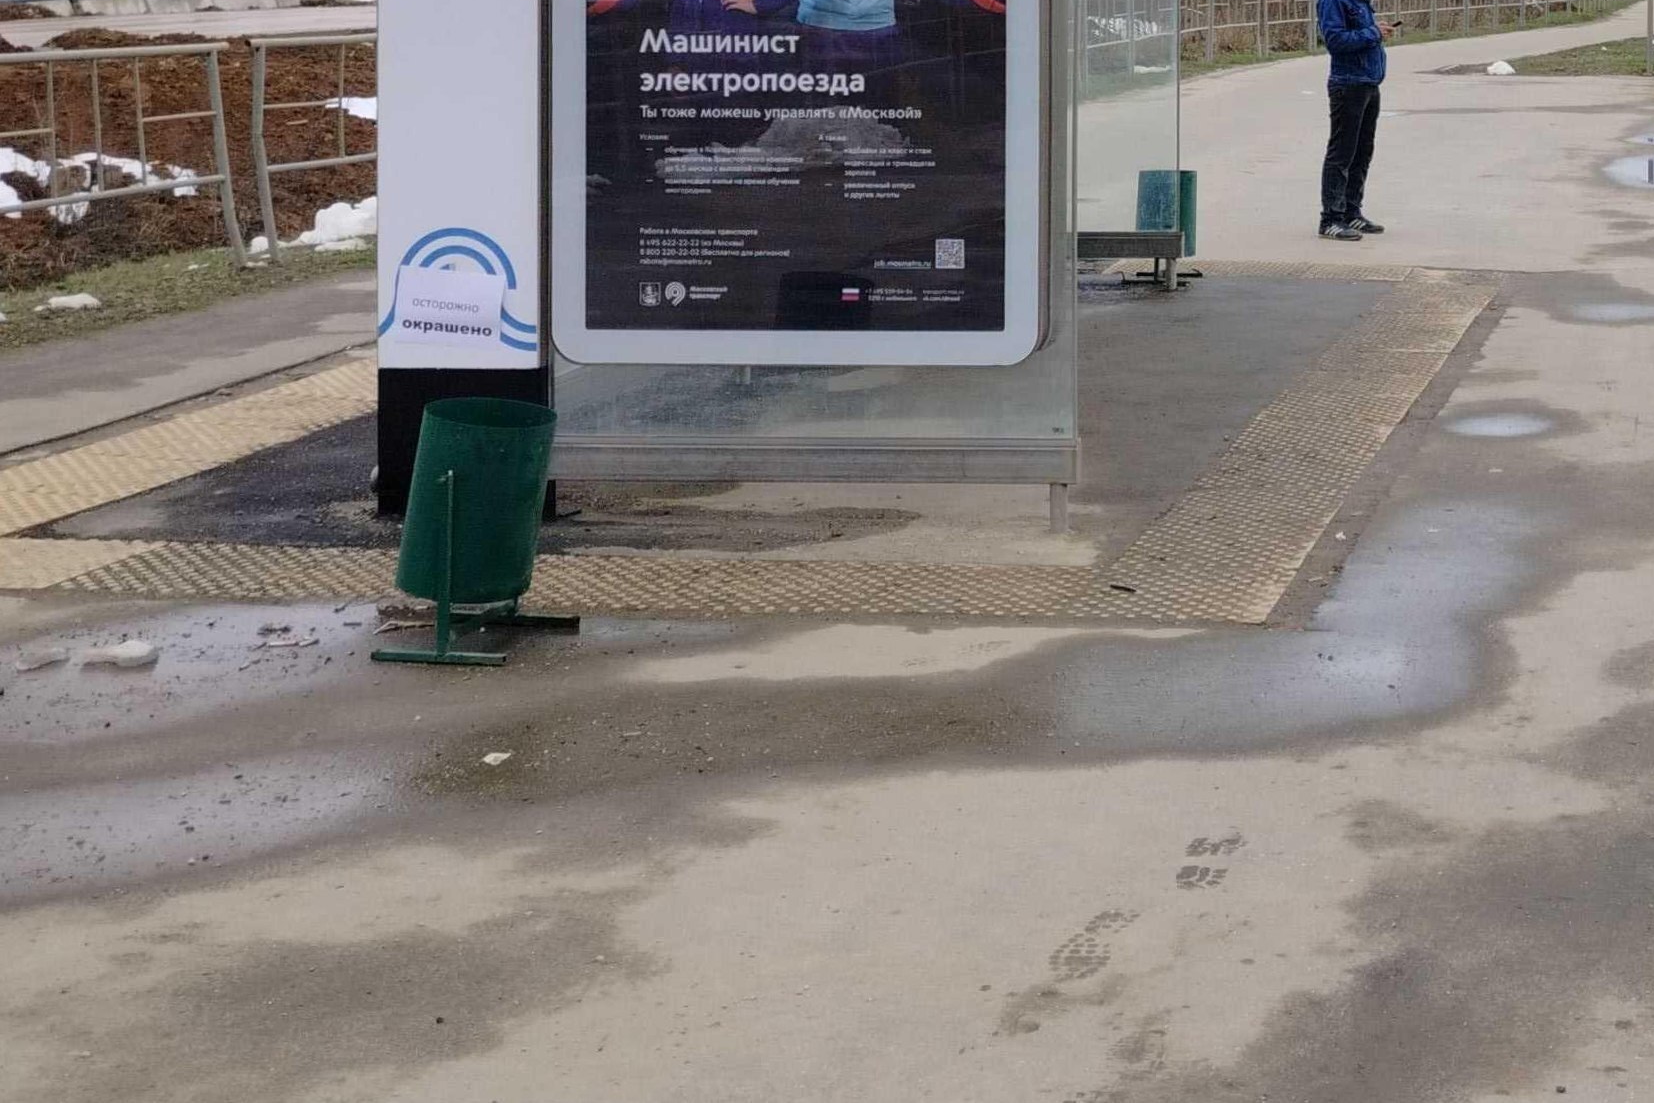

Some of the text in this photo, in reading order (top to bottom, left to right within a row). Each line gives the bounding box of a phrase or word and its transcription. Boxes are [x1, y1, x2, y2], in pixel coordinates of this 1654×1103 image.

[639, 28, 800, 54] Машинист
[639, 72, 865, 97] электропоезда
[640, 105, 922, 120] Ты тоже можешь управлять «Москвой»
[412, 298, 480, 313] осторожно
[402, 319, 492, 337] окрашено
